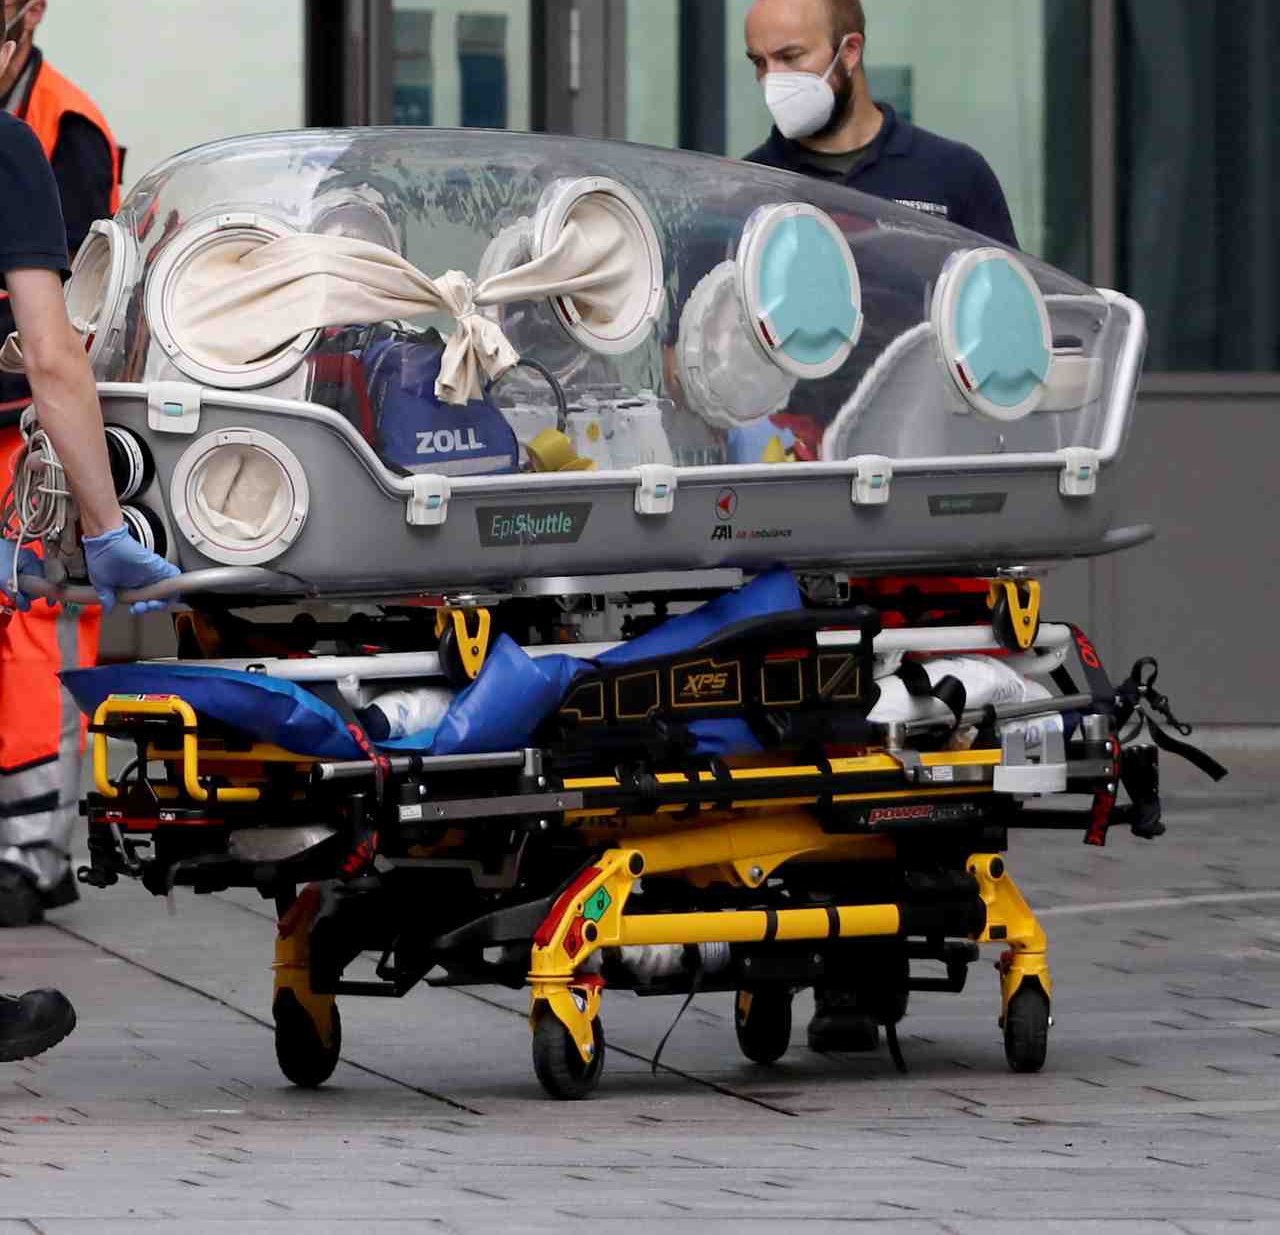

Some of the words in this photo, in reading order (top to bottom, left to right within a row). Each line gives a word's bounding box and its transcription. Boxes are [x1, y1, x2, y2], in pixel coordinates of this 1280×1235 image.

[416, 427, 484, 454] ZOLL
[491, 511, 572, 539] EpiShuttle
[683, 673, 728, 697] XPS
